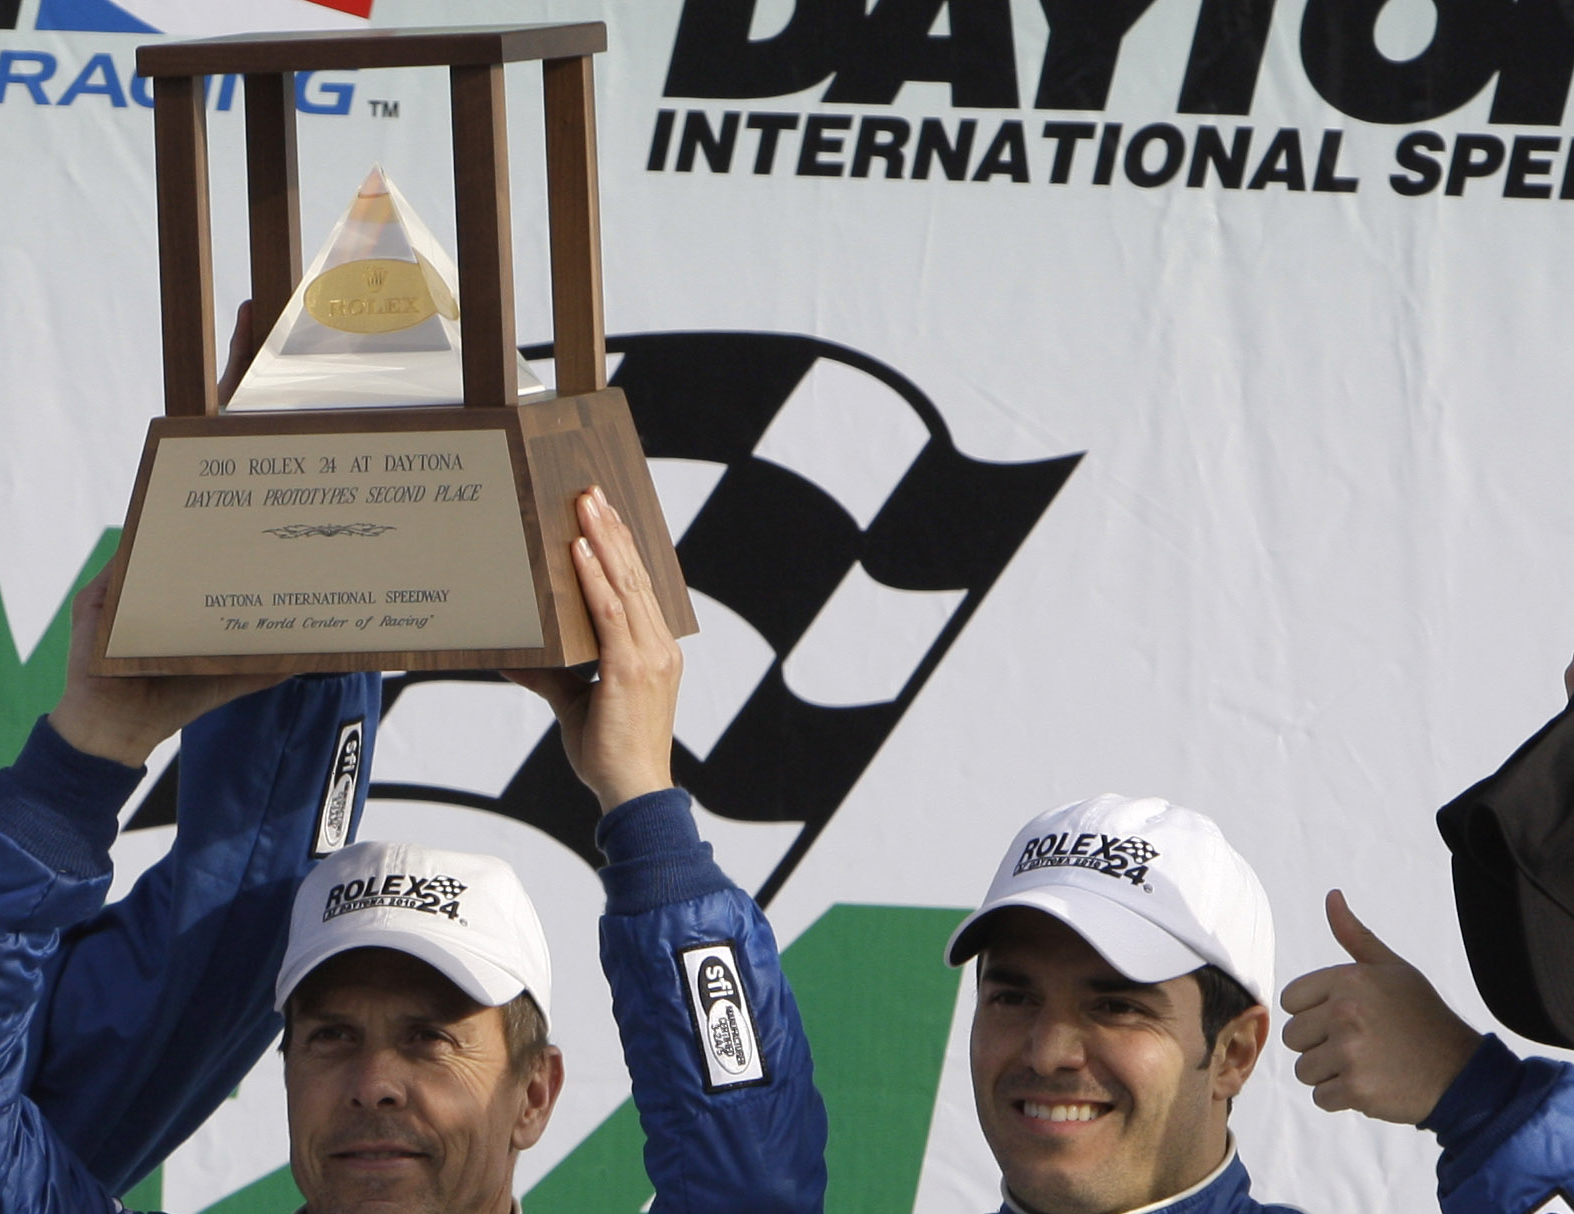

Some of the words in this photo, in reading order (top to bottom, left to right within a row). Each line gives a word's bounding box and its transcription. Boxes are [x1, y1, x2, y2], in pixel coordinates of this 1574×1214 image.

[645, 109, 1360, 193] INTERNATIONAL
[1389, 132, 1574, 201] SPE
[328, 296, 421, 318] ROLEX
[199, 458, 236, 477] 2010
[248, 457, 306, 476] ROLEX
[319, 456, 337, 474] 24
[350, 456, 373, 473] AT
[384, 453, 464, 472] DAYTONA
[183, 489, 253, 508] DAYTONA
[262, 486, 358, 506] PROTOTYPES
[365, 485, 426, 504] SECOND
[435, 483, 483, 502] PLACE
[205, 593, 263, 608] DAYTONA
[272, 592, 376, 607] INTERNATIONAL
[386, 589, 450, 604] SPEEDWAY
[256, 616, 295, 630] World
[302, 615, 348, 630] Center
[355, 615, 373, 631] of
[1018, 831, 1121, 863] ROLEX
[1099, 853, 1150, 886] 24
[326, 874, 427, 909] ROLEX
[417, 892, 461, 920] 24
[705, 965, 734, 998] sfi
